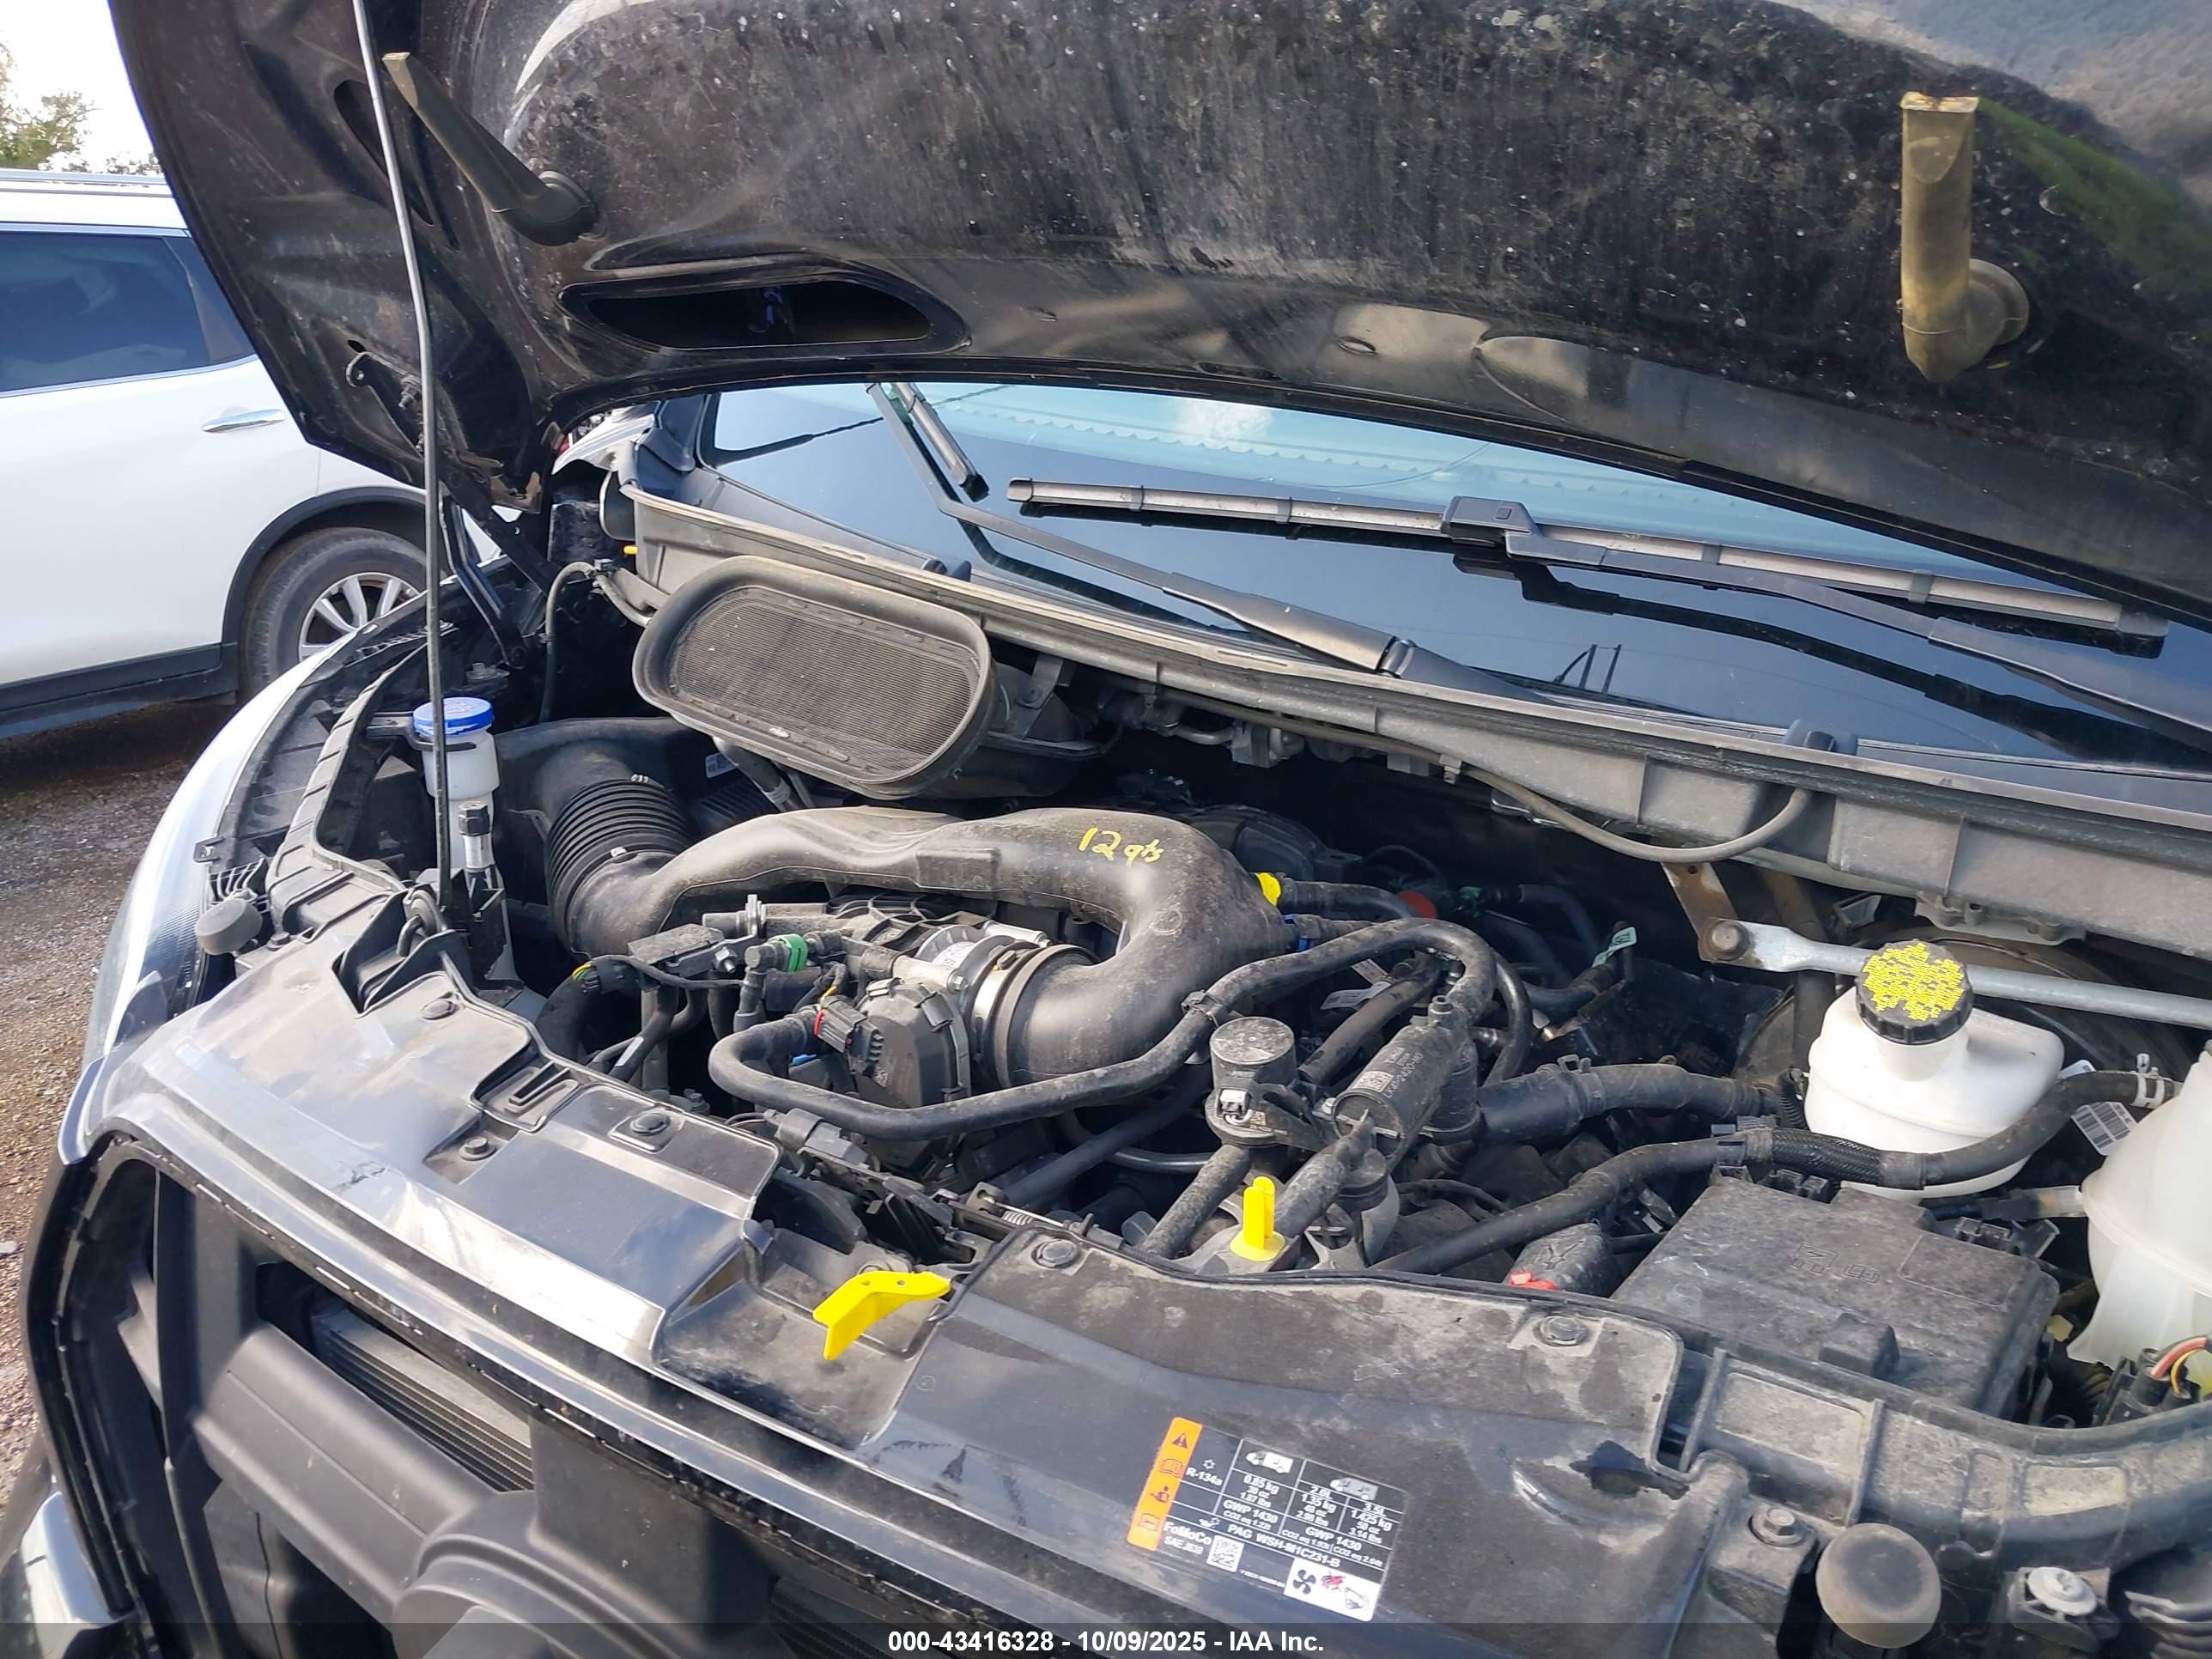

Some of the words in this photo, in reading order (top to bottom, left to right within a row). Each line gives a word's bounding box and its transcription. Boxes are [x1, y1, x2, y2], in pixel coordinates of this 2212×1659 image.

[1079, 827, 1121, 860] 12
[1186, 1467, 1223, 1486] R-134a
[1243, 1474, 1266, 1488] 0.85
[1265, 1482, 1279, 1495] kg
[1310, 1486, 1333, 1500] 2.0L
[1223, 1500, 1252, 1513] GWP
[1253, 1510, 1278, 1523] 1430
[1257, 1498, 1271, 1508] lbs
[1301, 1494, 1322, 1507] 1.35
[1322, 1500, 1337, 1513] kg
[1363, 1503, 1387, 1516] 3.5L
[1315, 1516, 1328, 1527] lbs
[1351, 1510, 1377, 1524] 1.425
[1378, 1518, 1393, 1531] kg
[1164, 1522, 1212, 1546] FoMoCo
[1227, 1523, 1253, 1539] PAG
[1305, 1527, 1334, 1540] GWP
[1335, 1536, 1362, 1551] 1430
[1348, 1528, 1368, 1539] 3.14
[1368, 1534, 1382, 1544] lbs
[1164, 1536, 1184, 1547] SAE
